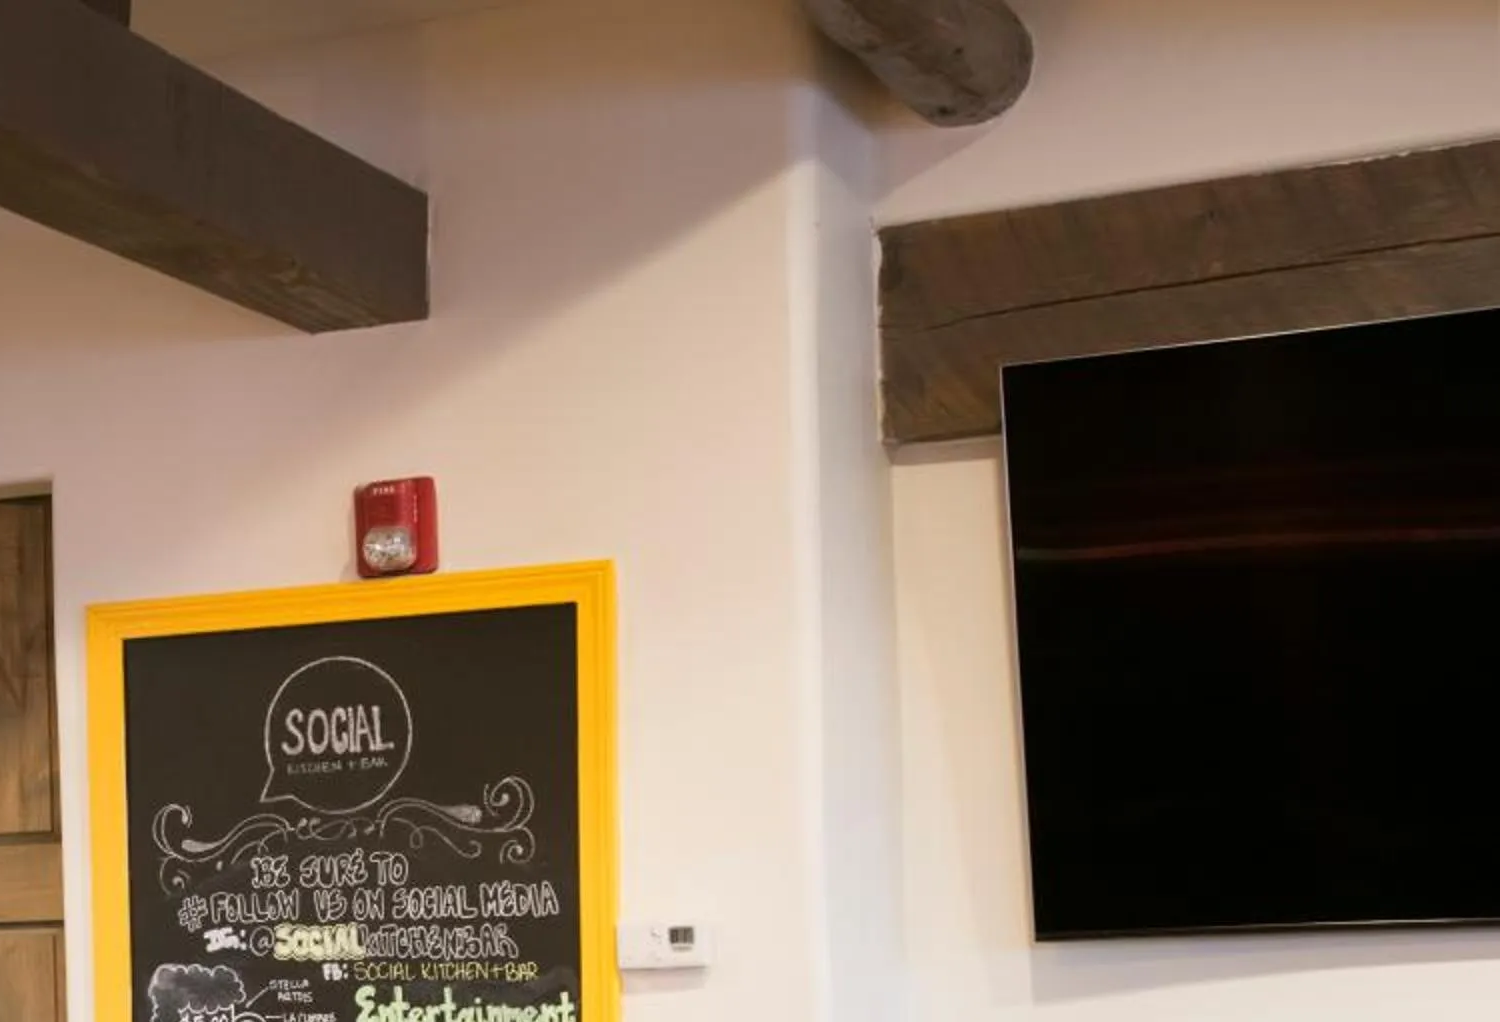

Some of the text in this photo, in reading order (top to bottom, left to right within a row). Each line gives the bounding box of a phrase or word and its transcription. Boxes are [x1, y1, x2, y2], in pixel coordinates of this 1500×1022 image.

[281, 704, 395, 755] SOCIAL
[252, 848, 409, 888] BE SURE TO
[313, 888, 348, 922] US
[351, 887, 385, 921] ON
[392, 885, 479, 920] SOCIAL
[479, 880, 560, 918] MEDIA
[353, 961, 415, 980] SOCIAL
